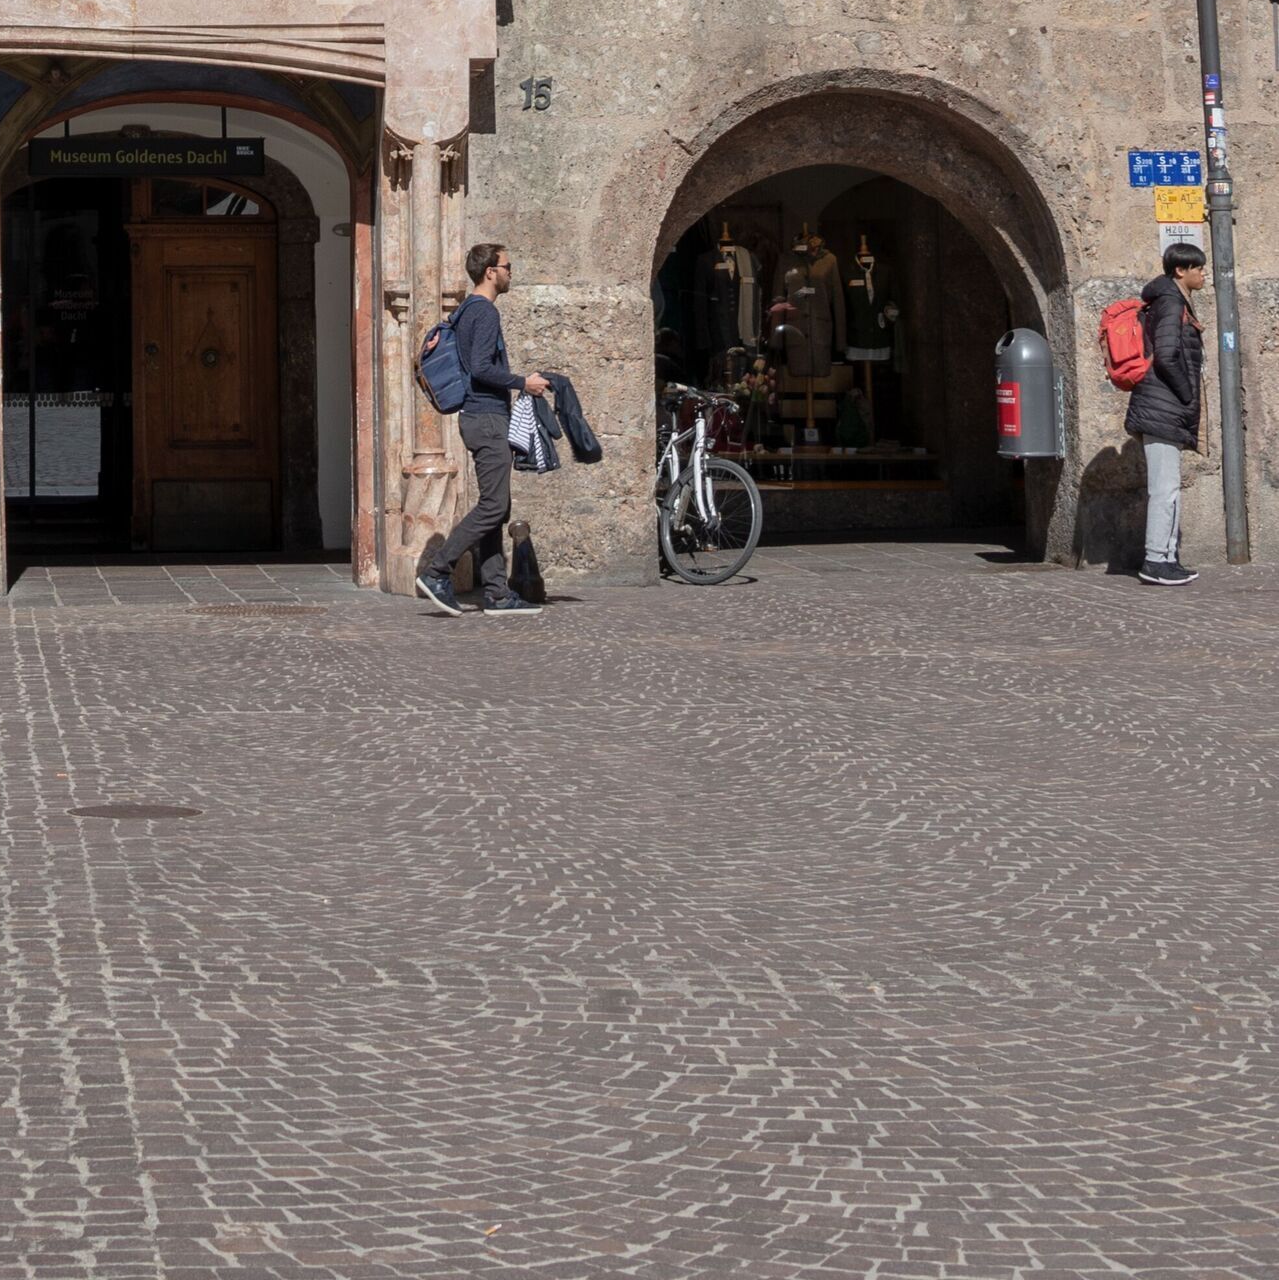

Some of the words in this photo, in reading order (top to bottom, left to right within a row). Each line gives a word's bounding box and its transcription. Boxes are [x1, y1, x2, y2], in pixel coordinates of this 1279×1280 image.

[520, 75, 553, 111] 15
[50, 150, 111, 164] Museum
[115, 149, 183, 165] Goldenes
[187, 149, 228, 165] Dachl
